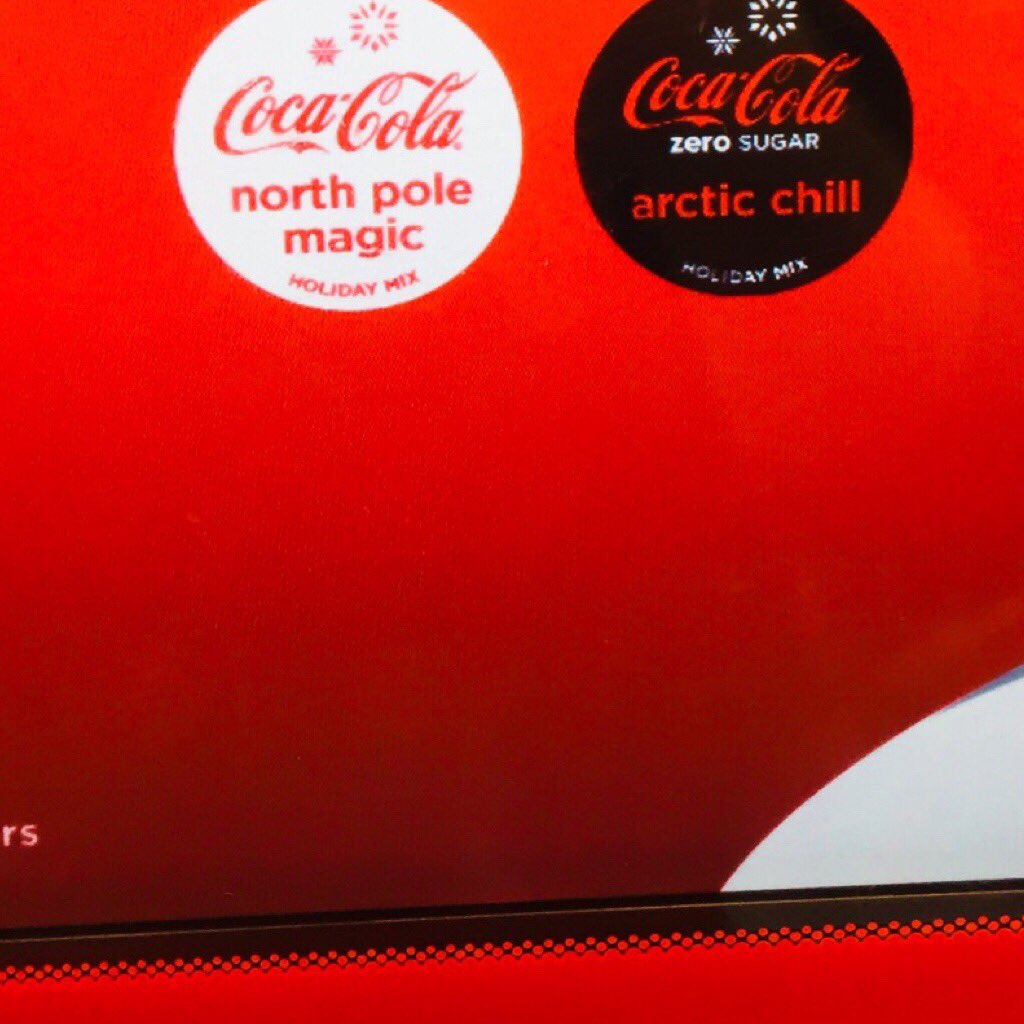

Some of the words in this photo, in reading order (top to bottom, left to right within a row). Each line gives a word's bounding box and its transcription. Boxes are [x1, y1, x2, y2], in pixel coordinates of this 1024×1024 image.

[622, 52, 862, 129] Coca-Cola
[213, 71, 478, 156] Coca-Cola
[669, 134, 732, 154] zero
[738, 132, 820, 152] SUGAR
[231, 173, 356, 212] north
[372, 171, 473, 215] pole
[631, 182, 755, 219] arctic
[770, 179, 862, 216] chill
[283, 216, 425, 259] magic
[288, 272, 378, 298] HOLIDAY
[383, 269, 421, 293] MIX
[681, 262, 768, 285] HOLIDAY
[772, 258, 809, 280] MIX
